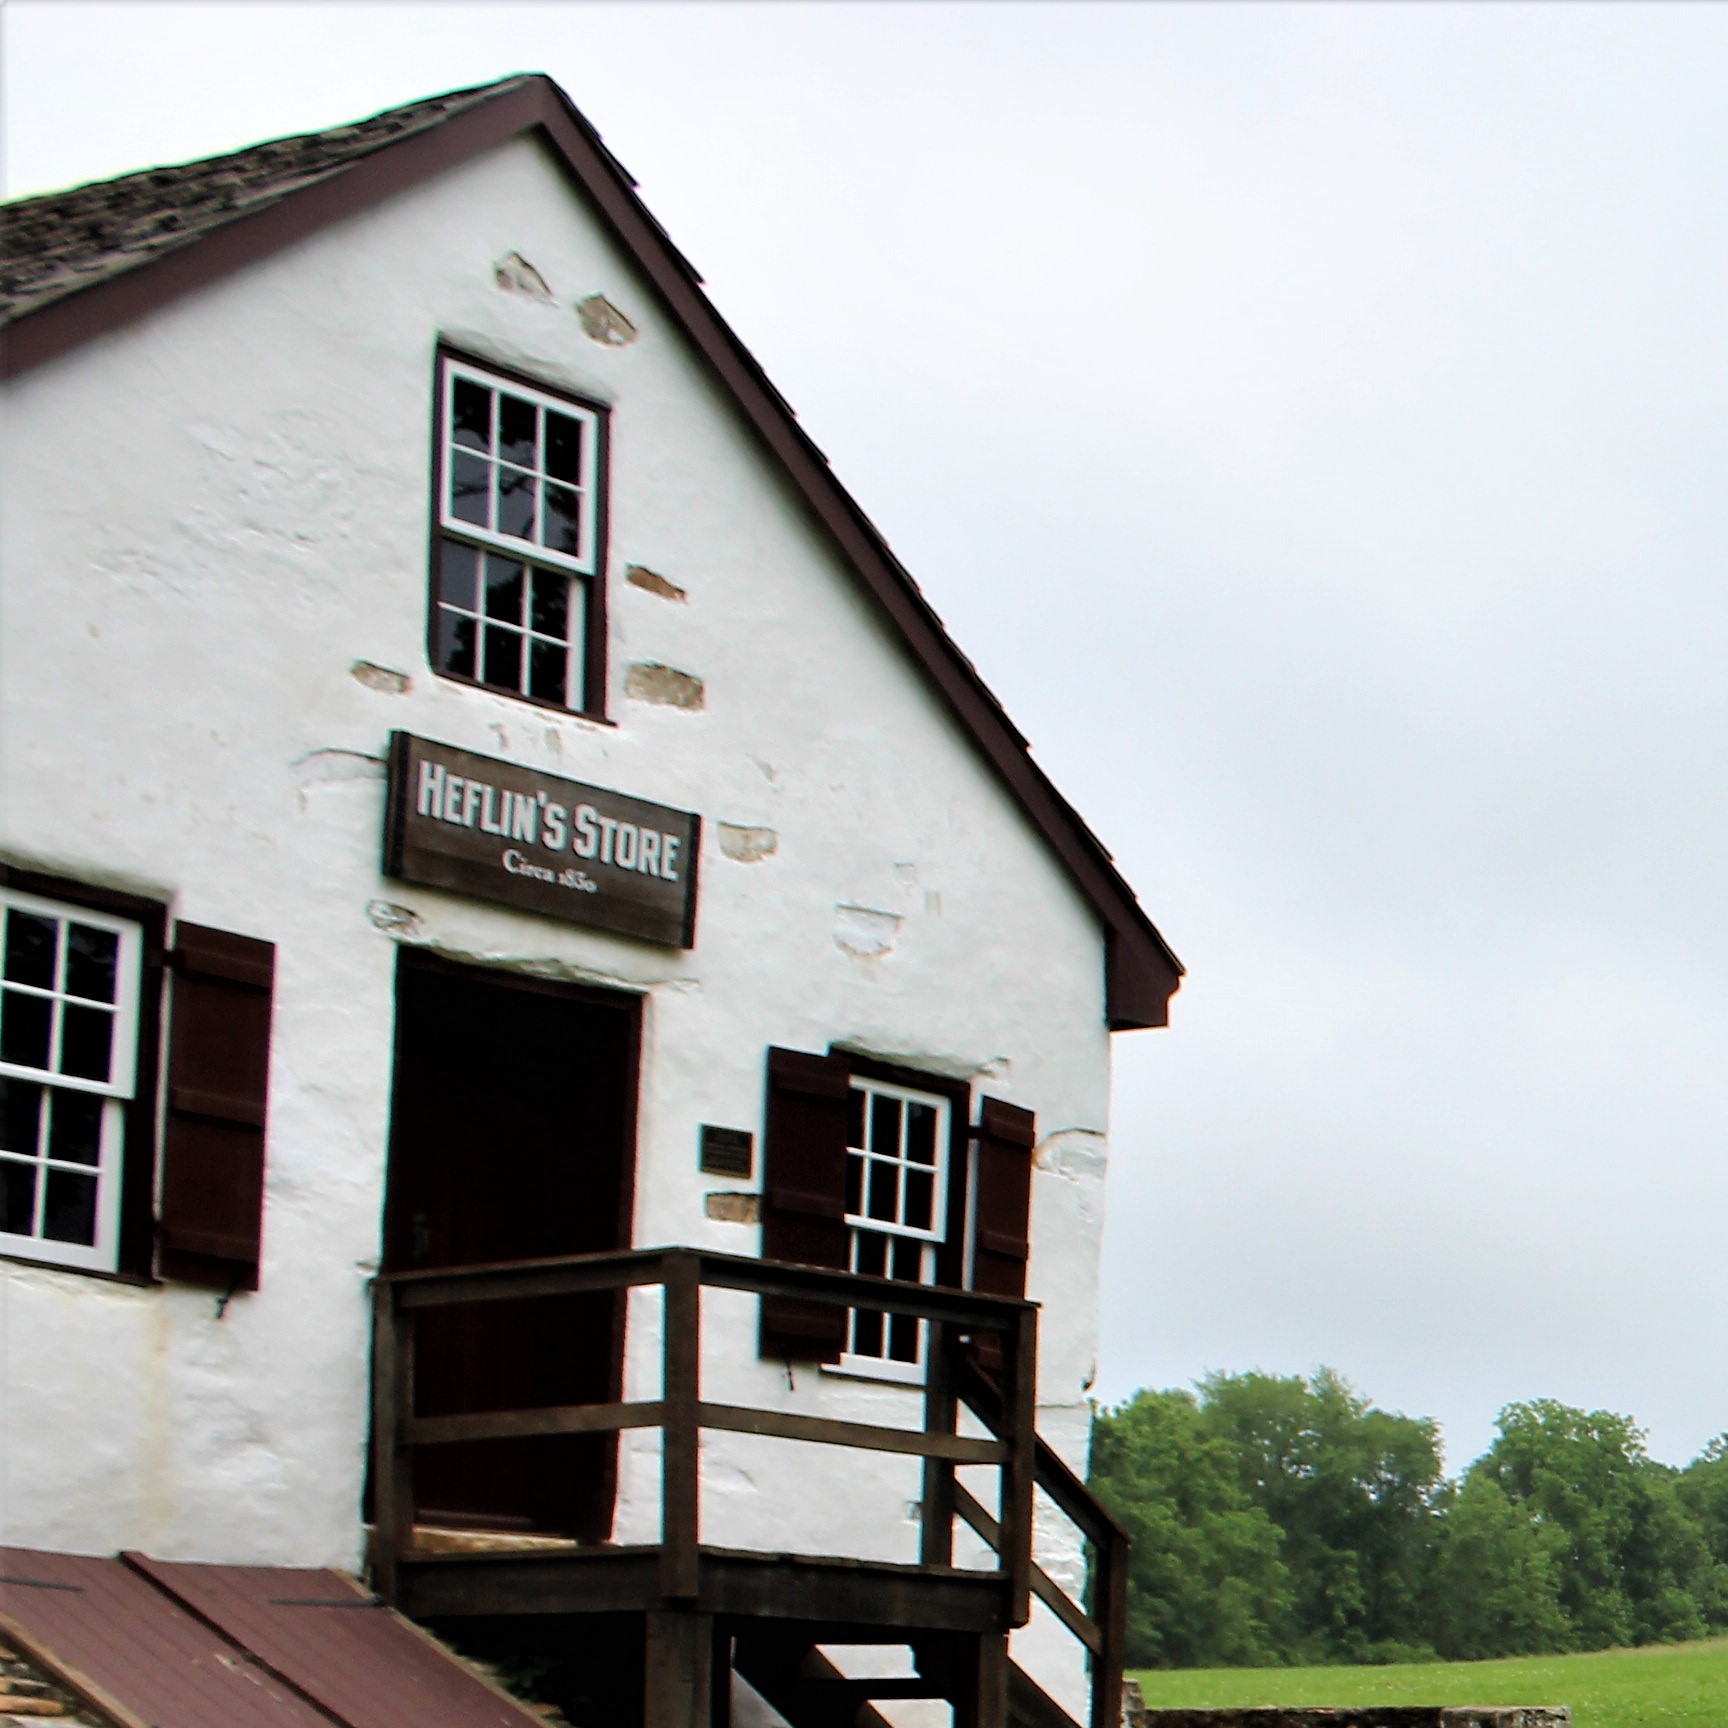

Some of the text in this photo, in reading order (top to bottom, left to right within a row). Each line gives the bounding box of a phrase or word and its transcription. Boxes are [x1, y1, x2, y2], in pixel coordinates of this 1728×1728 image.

[417, 759, 681, 881] HEFLIN'S STORE
[502, 848, 556, 883] Circa
